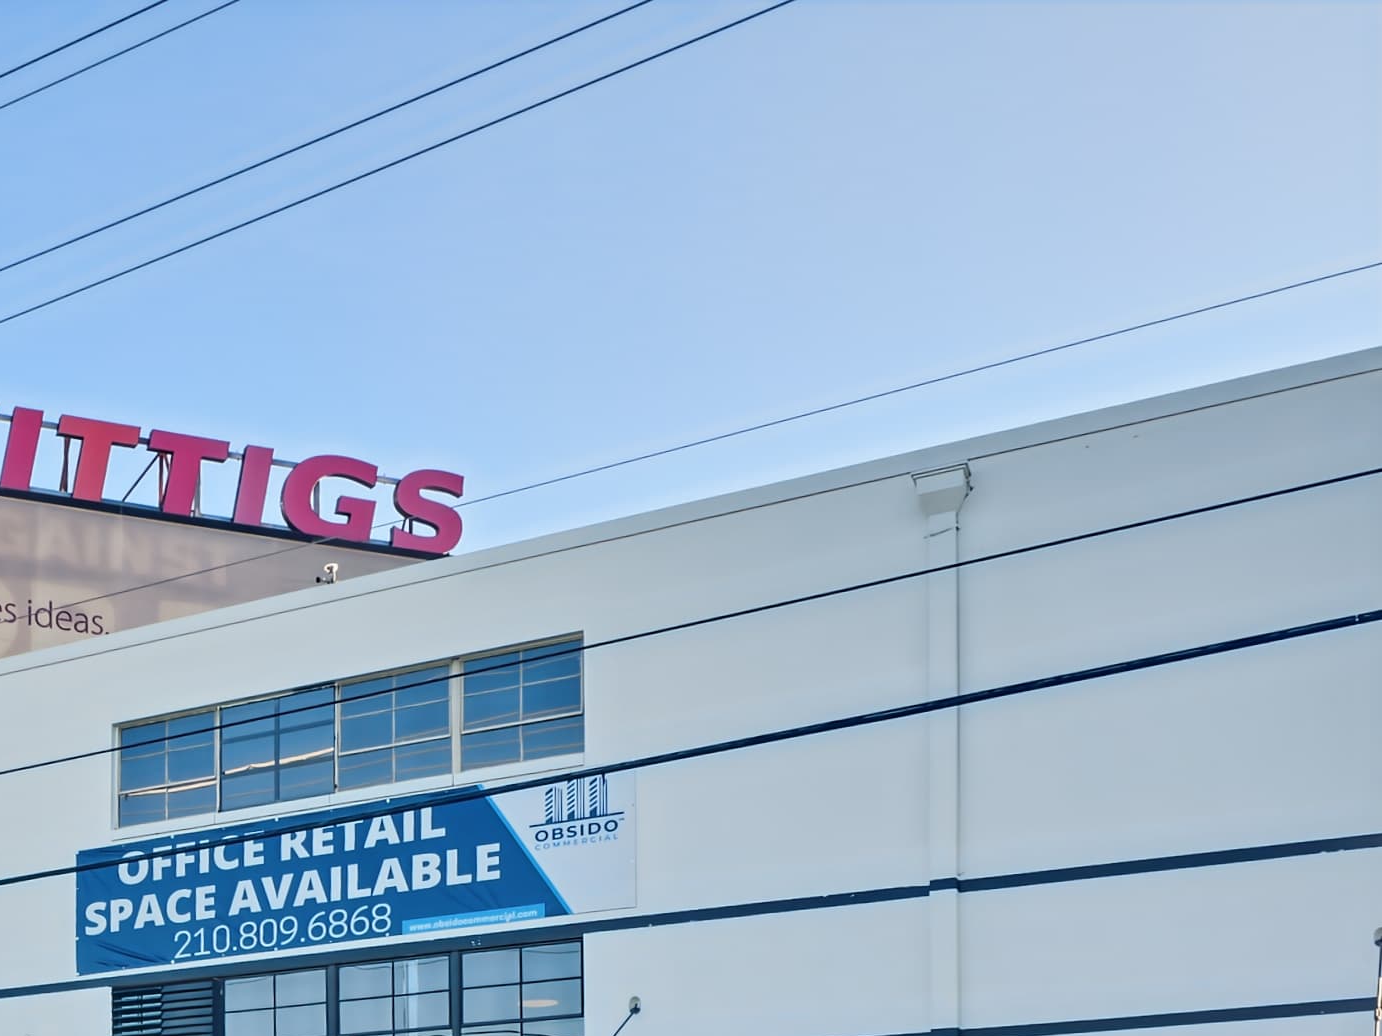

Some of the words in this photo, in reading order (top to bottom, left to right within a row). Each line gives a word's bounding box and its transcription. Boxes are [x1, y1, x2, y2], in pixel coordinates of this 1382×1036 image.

[26, 599, 112, 636] ideas.
[118, 830, 265, 886] OFFICE
[280, 806, 447, 862] RETAIL
[534, 833, 619, 851] COMMERCIAL
[535, 819, 619, 843] OBSIDO
[84, 883, 217, 937] SPACE
[227, 842, 502, 918] AVAILABLE
[173, 902, 392, 961] 210.809.6868
